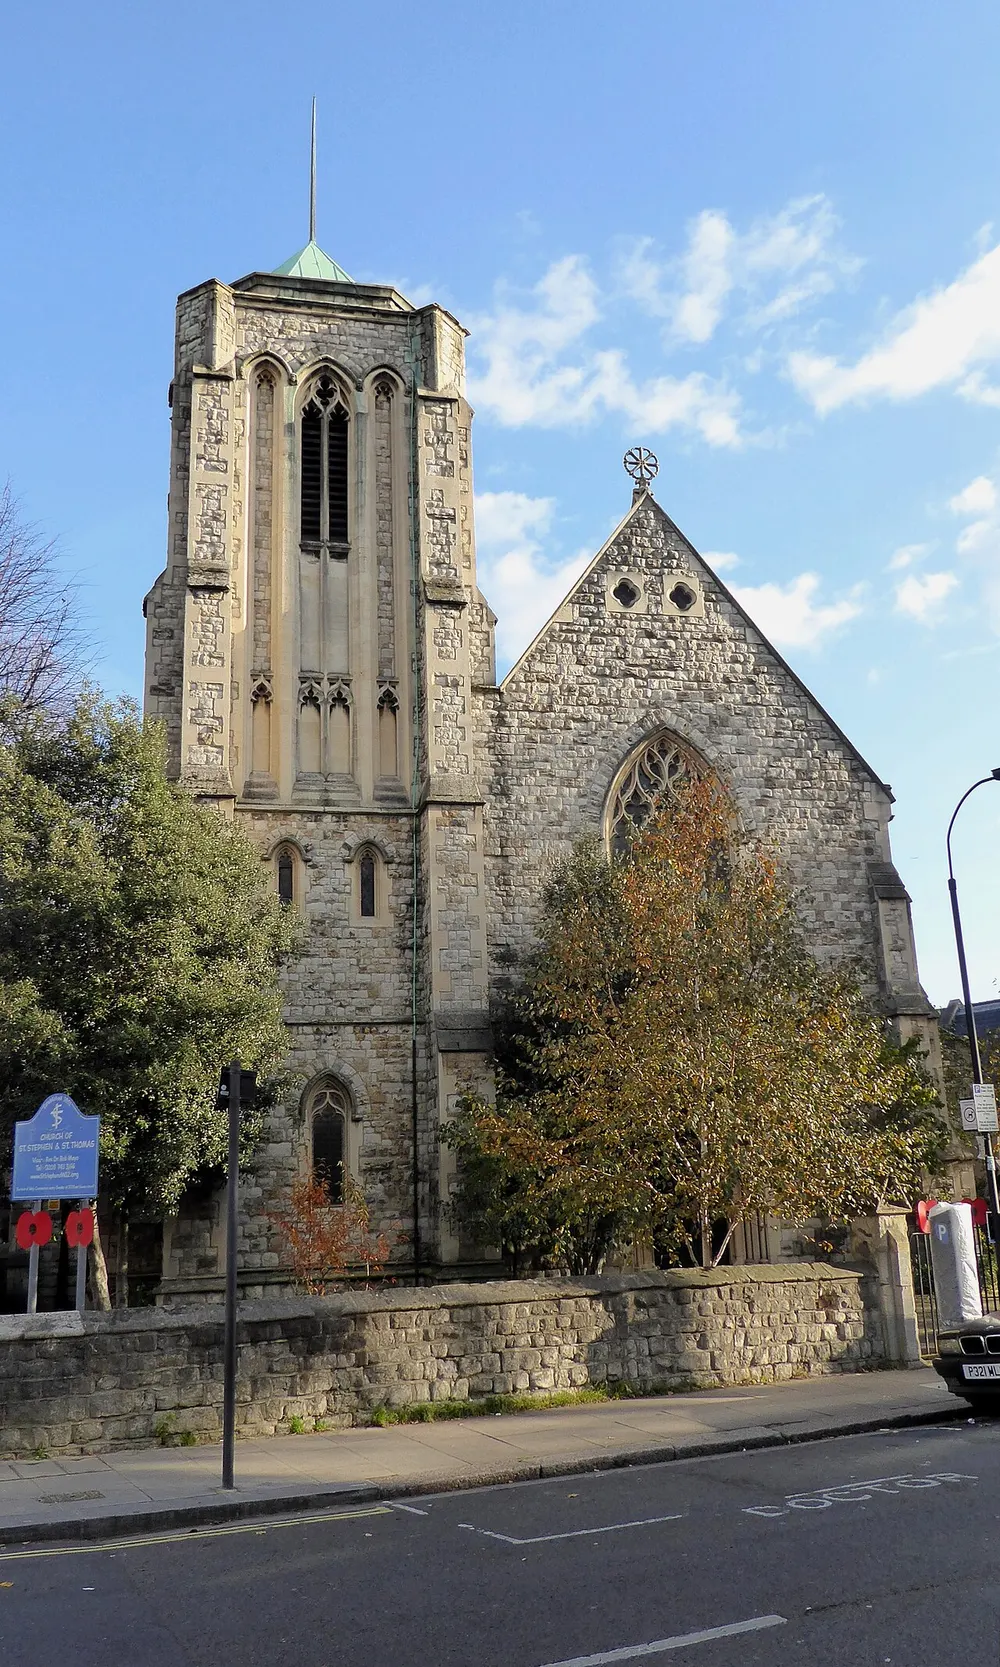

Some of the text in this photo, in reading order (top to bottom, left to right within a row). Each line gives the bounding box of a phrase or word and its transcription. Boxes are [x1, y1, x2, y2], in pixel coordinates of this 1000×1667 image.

[40, 1132, 73, 1140] CHURCH OF
[27, 1143, 53, 1152] STEPHEN
[71, 1140, 94, 1149] THOMAS
[938, 1224, 946, 1240] P
[968, 1366, 987, 1377] P321
[741, 1472, 980, 1517] DOCTOR
